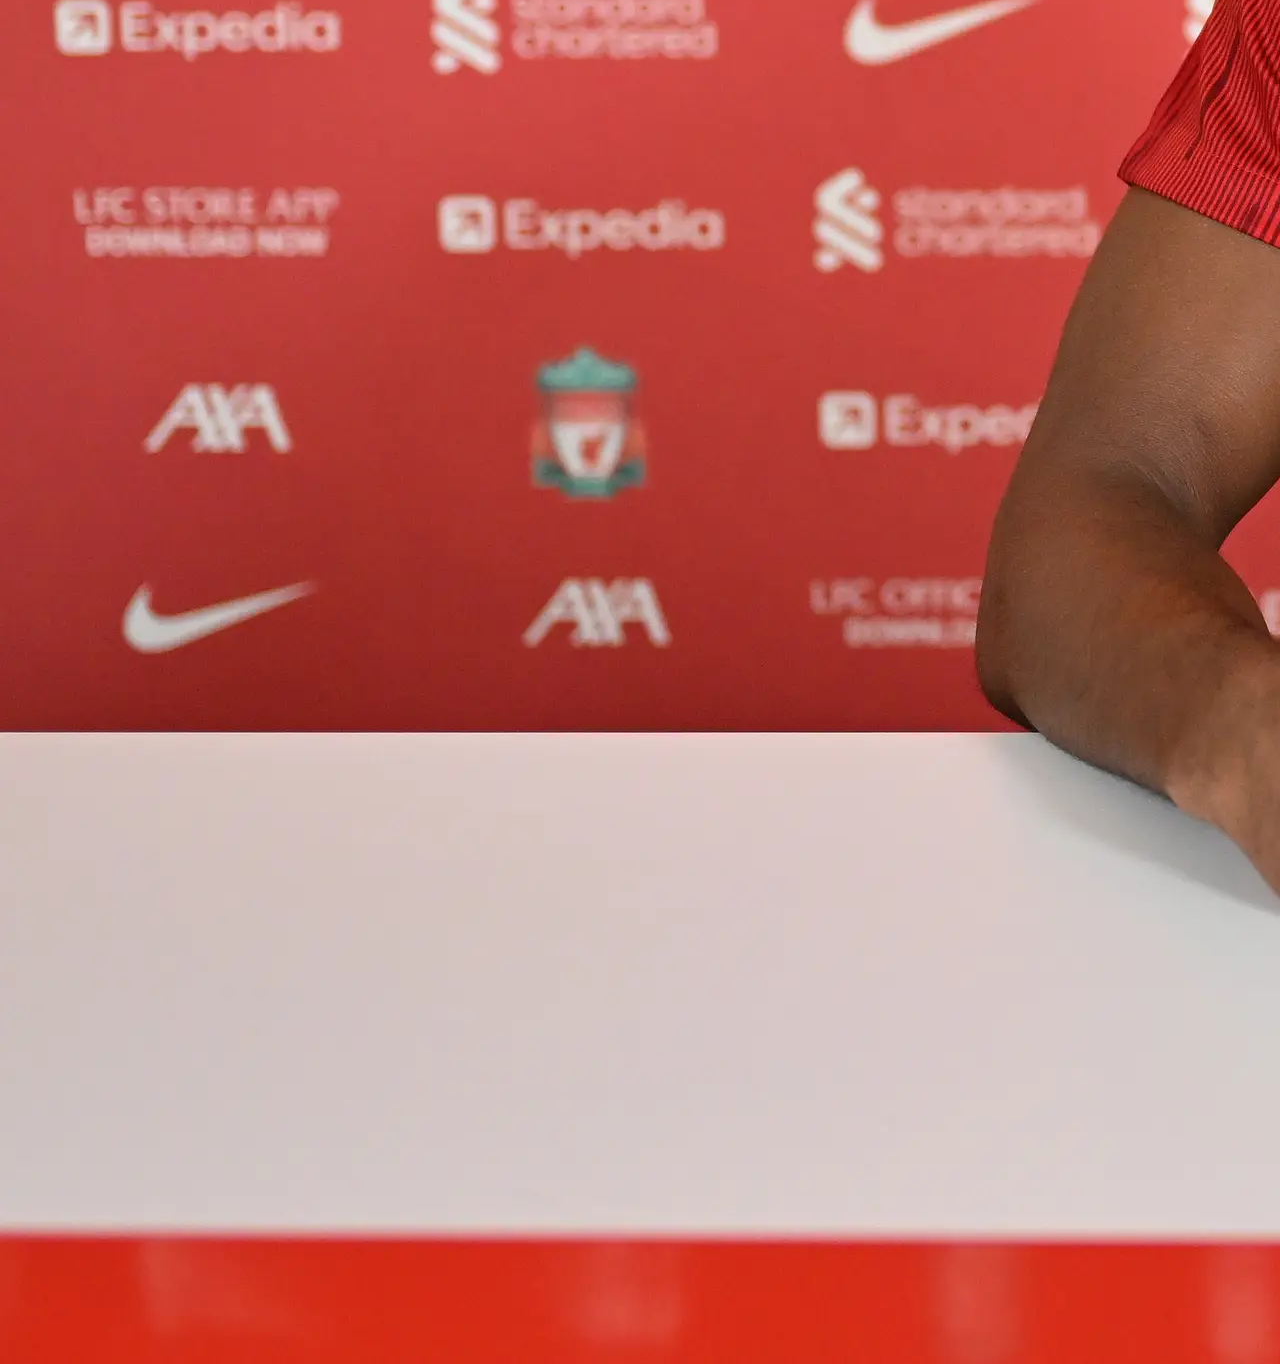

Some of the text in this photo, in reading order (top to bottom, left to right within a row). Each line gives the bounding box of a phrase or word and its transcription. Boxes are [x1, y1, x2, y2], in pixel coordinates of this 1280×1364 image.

[119, 1, 341, 60] Expedia
[511, 21, 718, 59] chartered
[73, 187, 339, 224] LFC STORE APP
[503, 198, 725, 257] Expedia
[894, 186, 1090, 222] standard
[894, 219, 1102, 258] chartered
[146, 384, 291, 452] AXA
[524, 578, 670, 646] AXA
